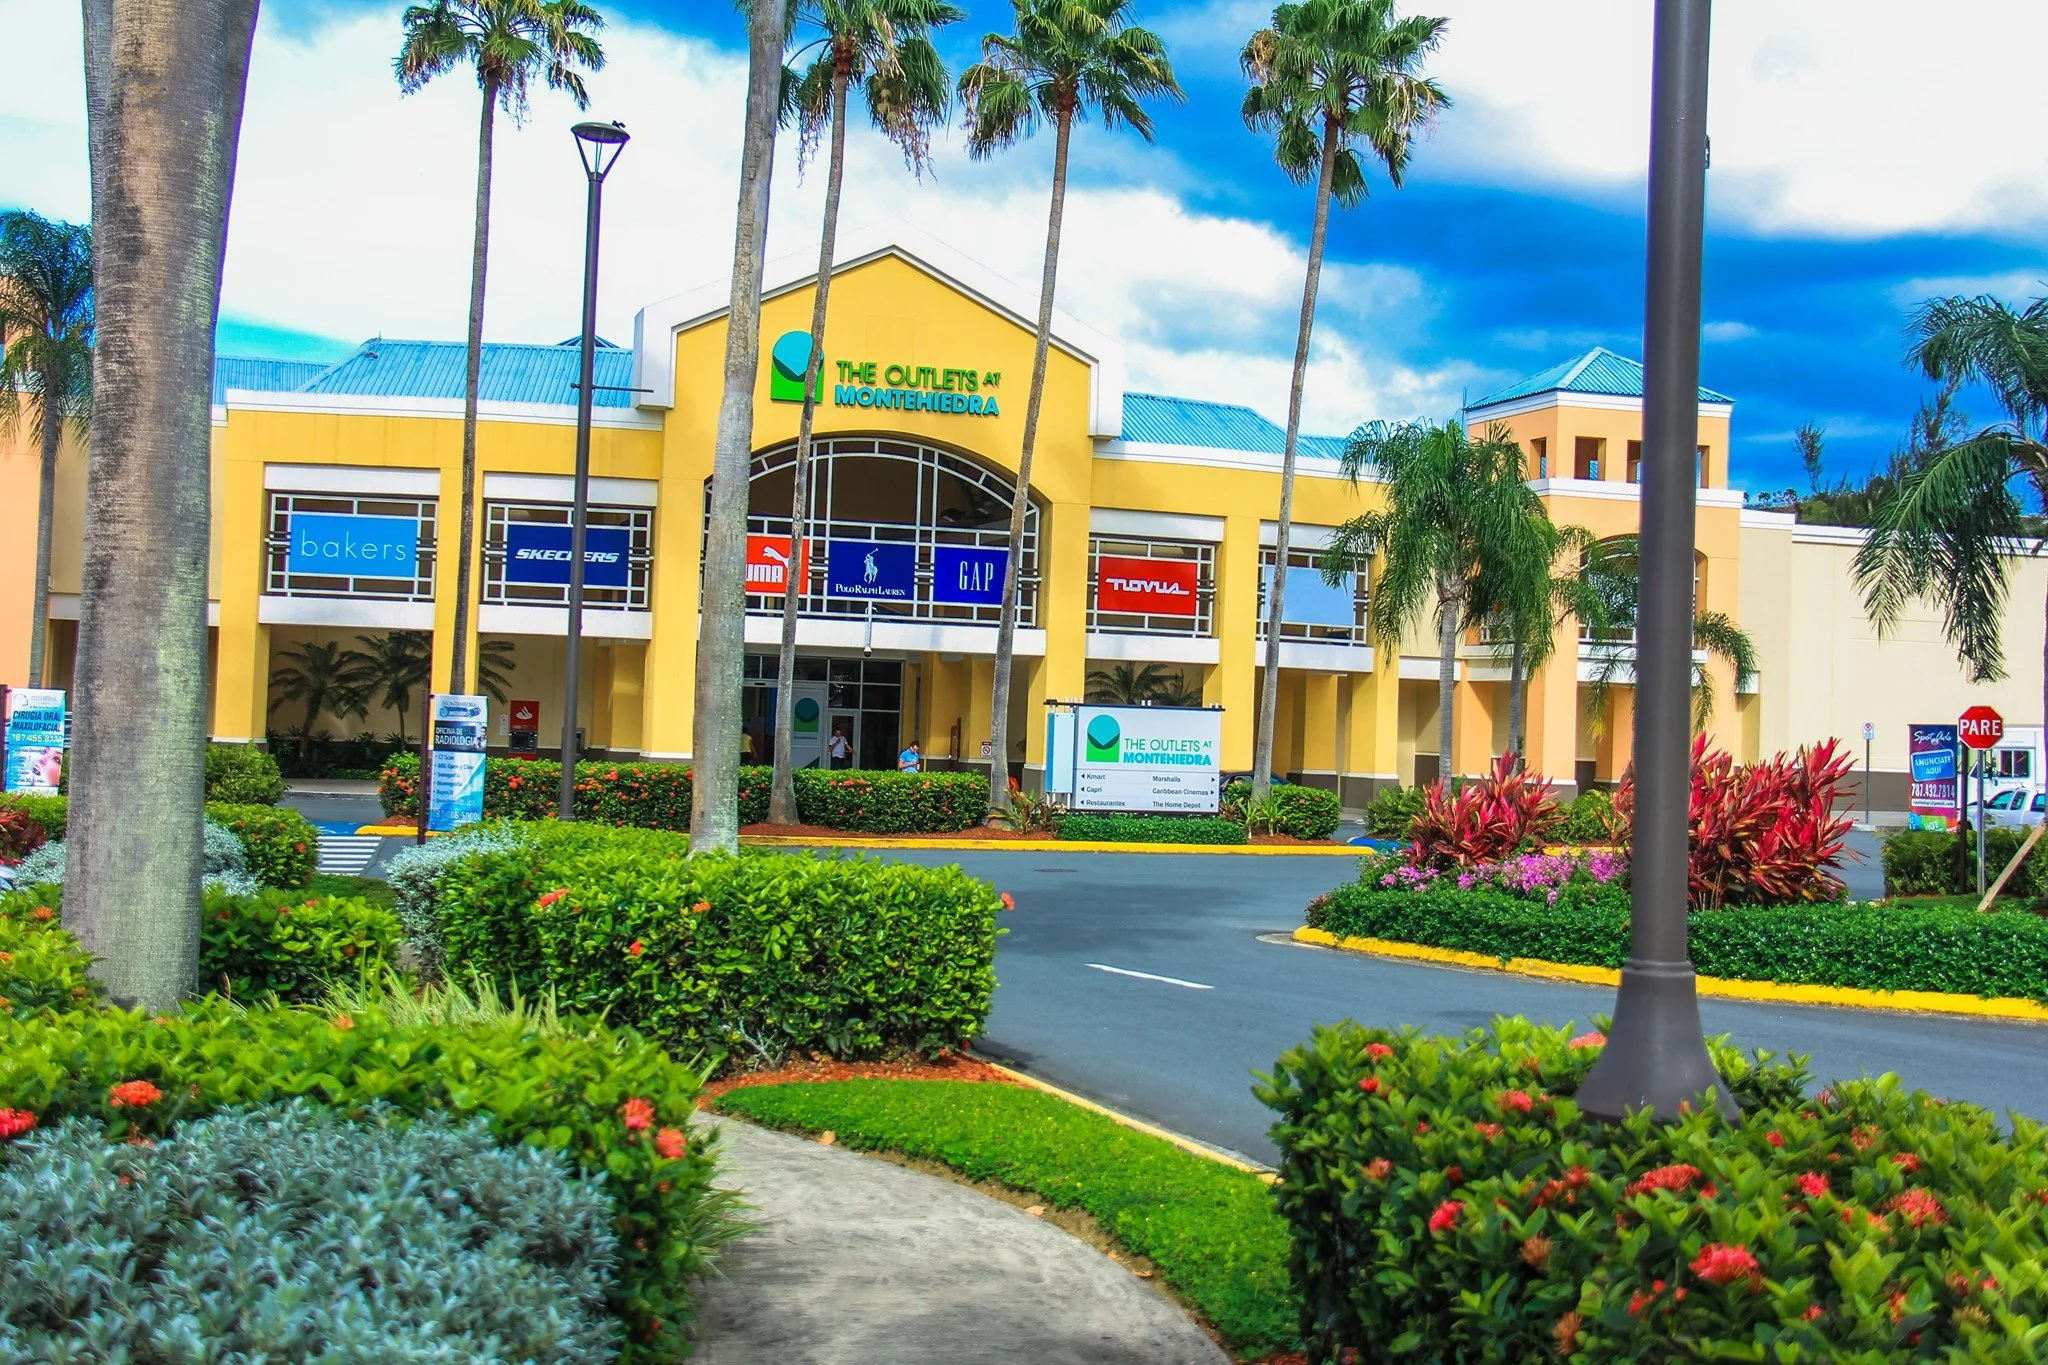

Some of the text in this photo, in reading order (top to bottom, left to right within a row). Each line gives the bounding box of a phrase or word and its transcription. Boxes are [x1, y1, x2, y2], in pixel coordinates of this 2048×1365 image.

[836, 360, 1001, 391] THE OUTLETS AT
[835, 384, 999, 416] MONTEHIEDRA
[301, 529, 406, 561] bakers
[745, 563, 784, 584] UMA
[959, 560, 994, 592] GAP
[43, 711, 61, 722] ORAL
[12, 721, 60, 732] MAXILOFACIAL
[1960, 719, 2001, 736] PARE
[1124, 738, 1146, 750] THE
[1149, 739, 1200, 752] OUTLETS
[1914, 730, 1935, 744] Spot
[1123, 752, 1212, 765] MONTEHIEDRA
[1911, 783, 1955, 798] 787.432.7814
